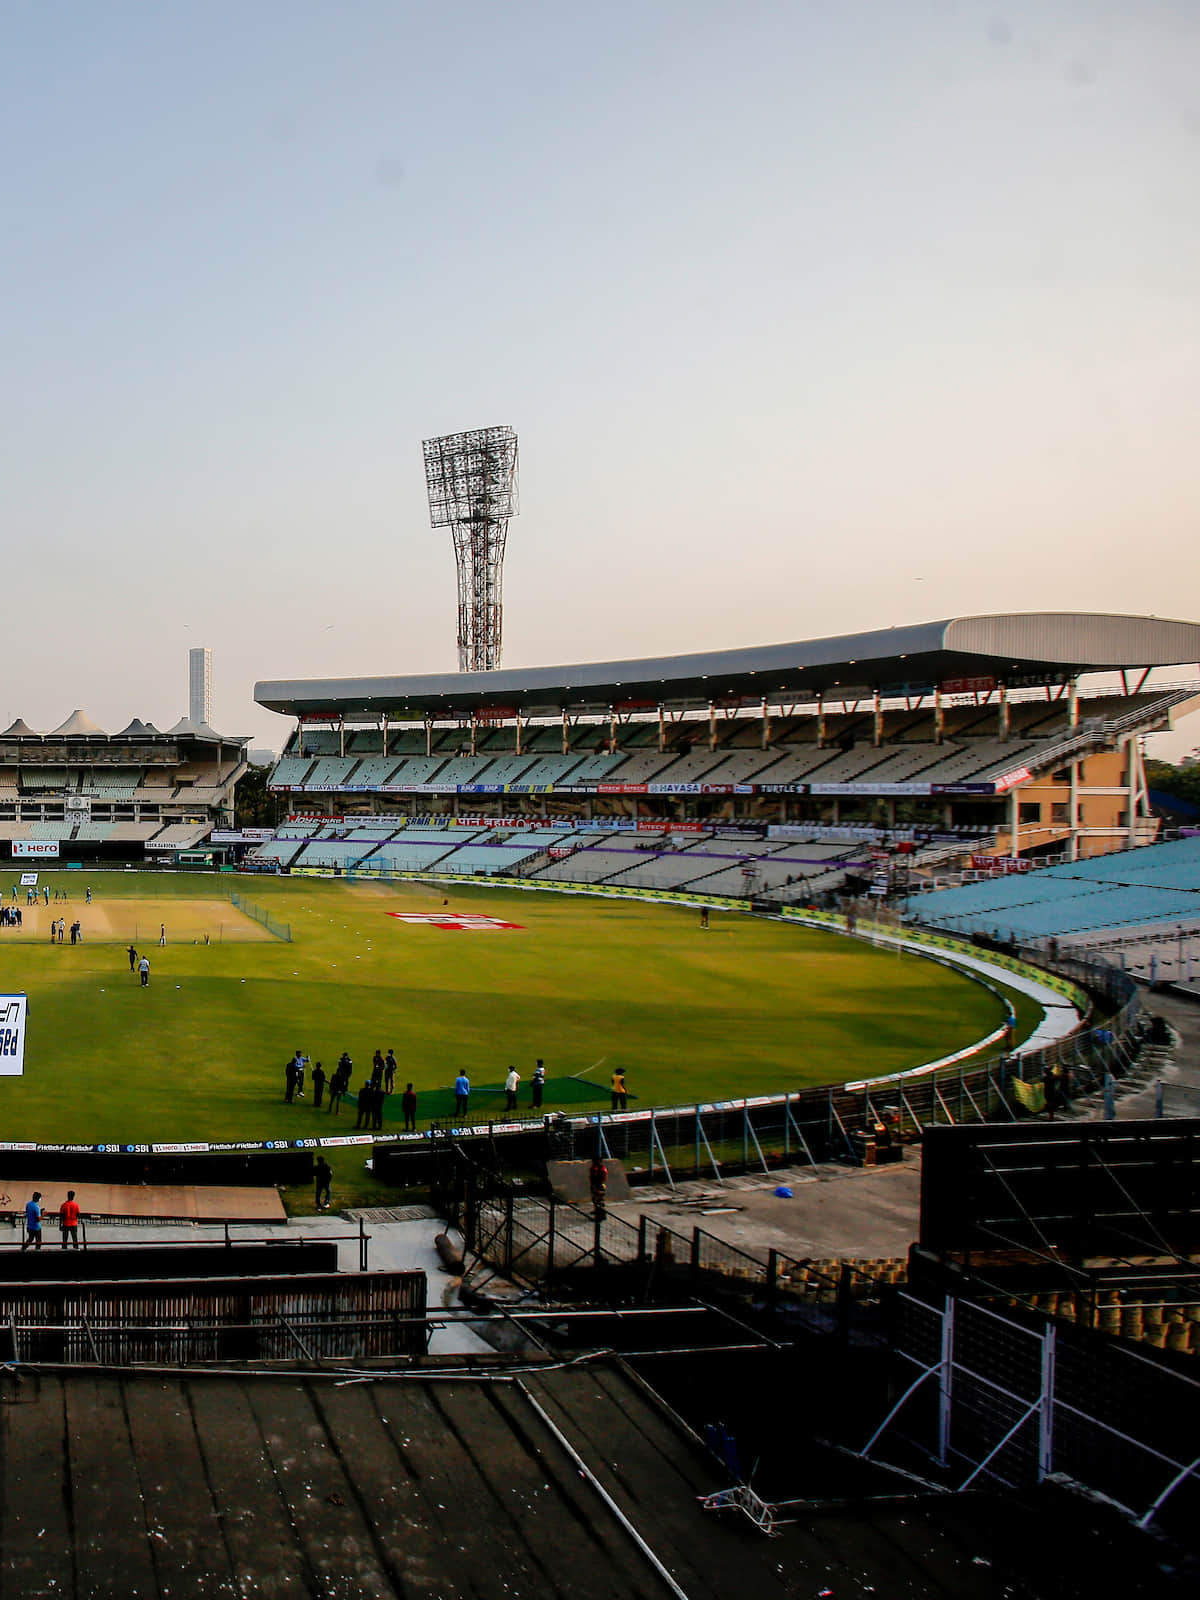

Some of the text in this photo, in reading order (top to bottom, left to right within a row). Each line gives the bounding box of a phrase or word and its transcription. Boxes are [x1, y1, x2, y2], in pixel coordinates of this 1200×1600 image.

[761, 785, 796, 793] TURTLE
[432, 817, 452, 827] TMT
[458, 818, 480, 827] पान
[304, 1139, 318, 1147] SBI
[106, 1144, 149, 1152] SBI SBI
